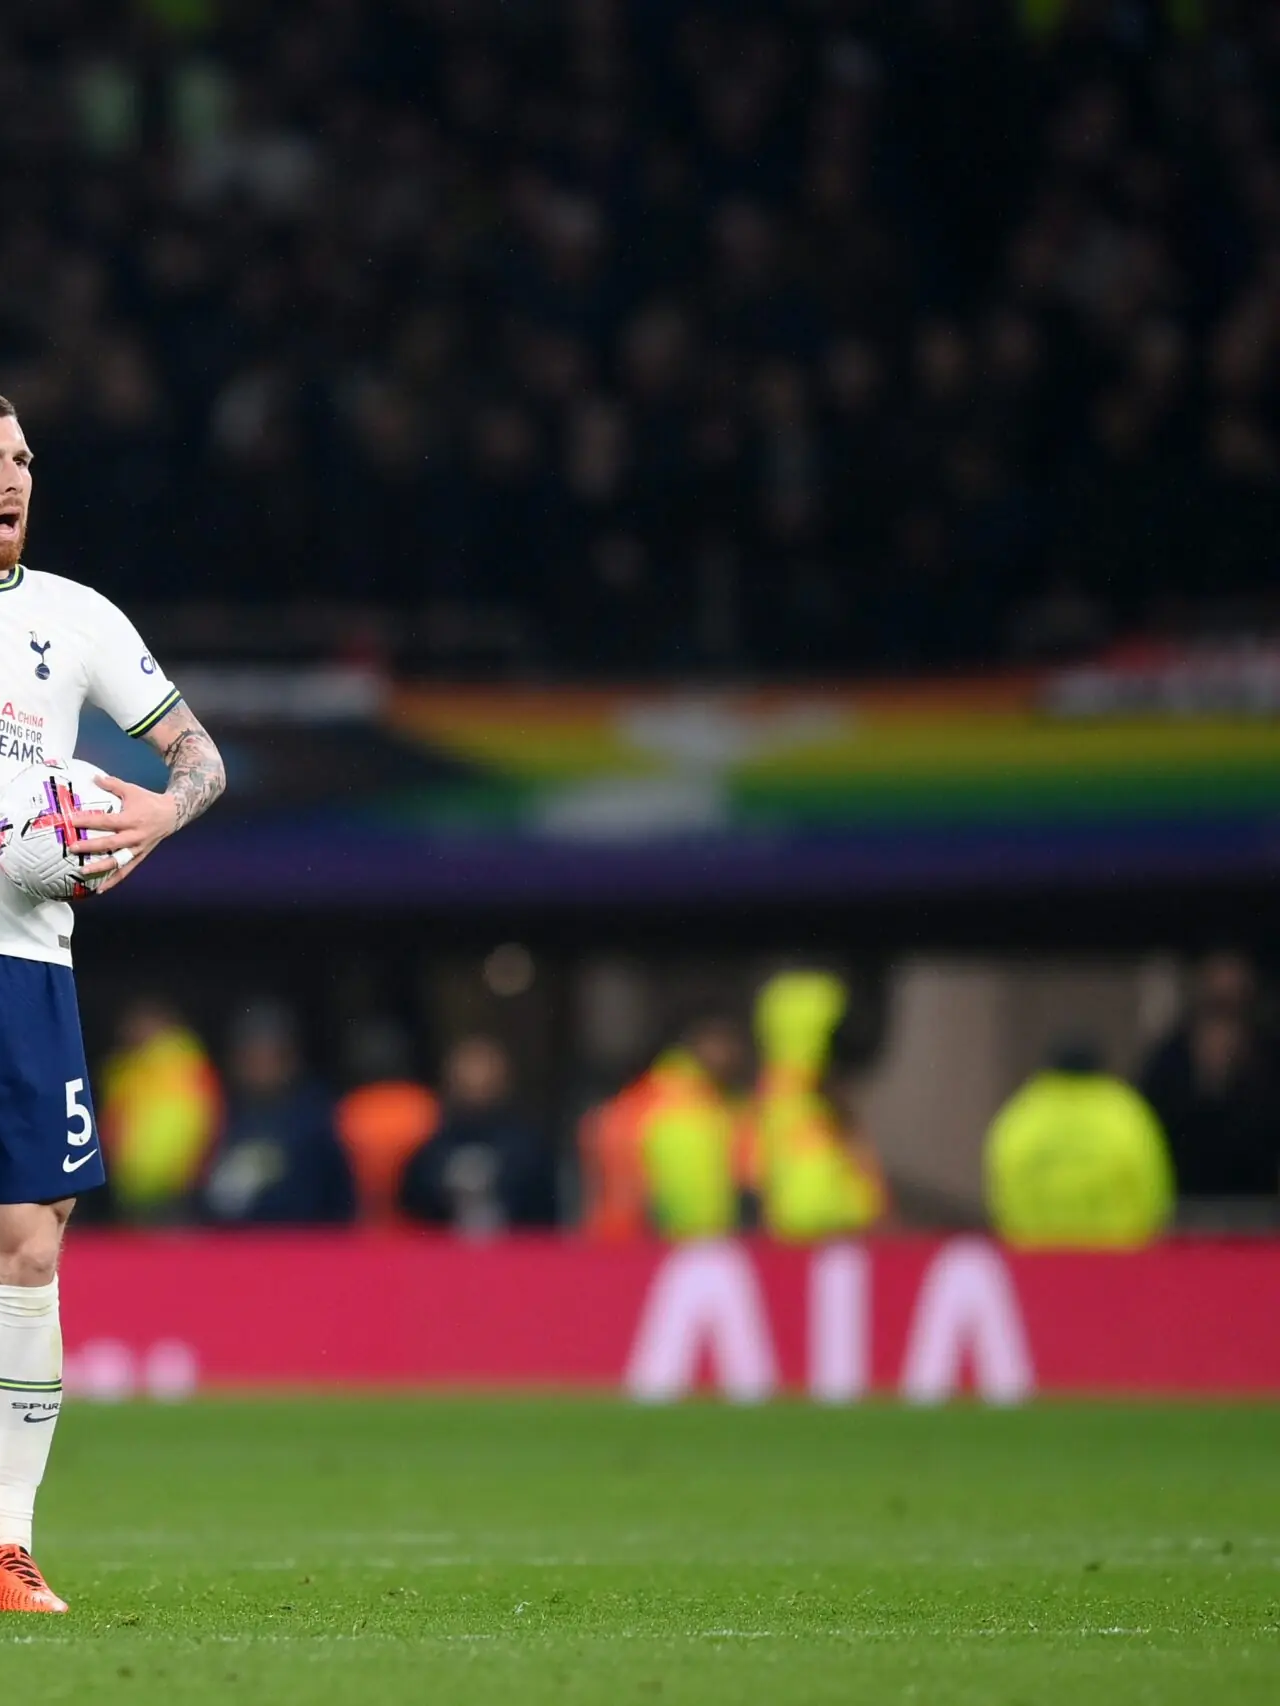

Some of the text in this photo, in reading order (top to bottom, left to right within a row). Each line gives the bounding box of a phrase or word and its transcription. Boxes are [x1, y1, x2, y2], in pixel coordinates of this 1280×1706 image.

[18, 710, 44, 728] CHINA
[25, 728, 43, 744] FOR
[65, 1077, 93, 1147] 5
[624, 1236, 1037, 1405] AIA
[10, 1401, 61, 1411] SPUR
